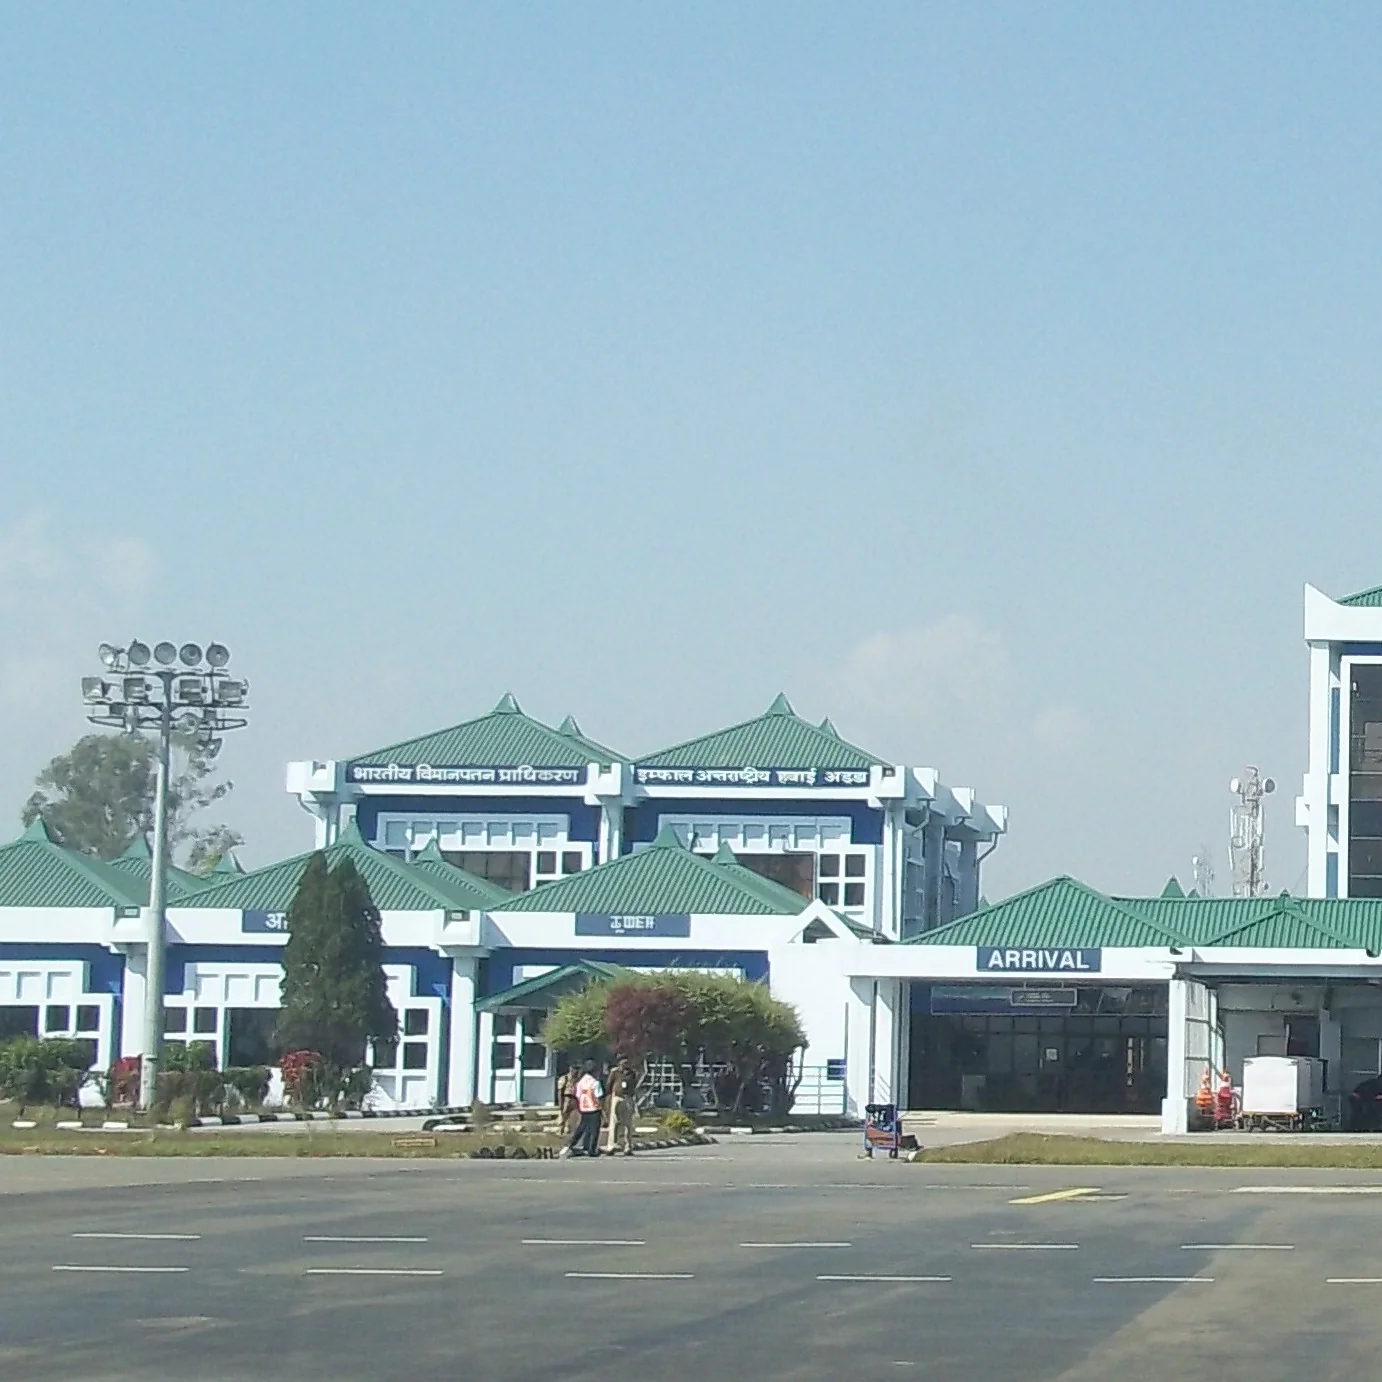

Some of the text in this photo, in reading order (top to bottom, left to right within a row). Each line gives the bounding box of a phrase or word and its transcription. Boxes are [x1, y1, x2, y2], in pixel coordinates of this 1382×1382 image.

[353, 763, 414, 782] भारतीय
[498, 764, 579, 784] प्राधिकरण
[637, 768, 693, 784] इम्फाल
[776, 768, 818, 787] हवाई
[988, 949, 1090, 969] ARRIVAL
